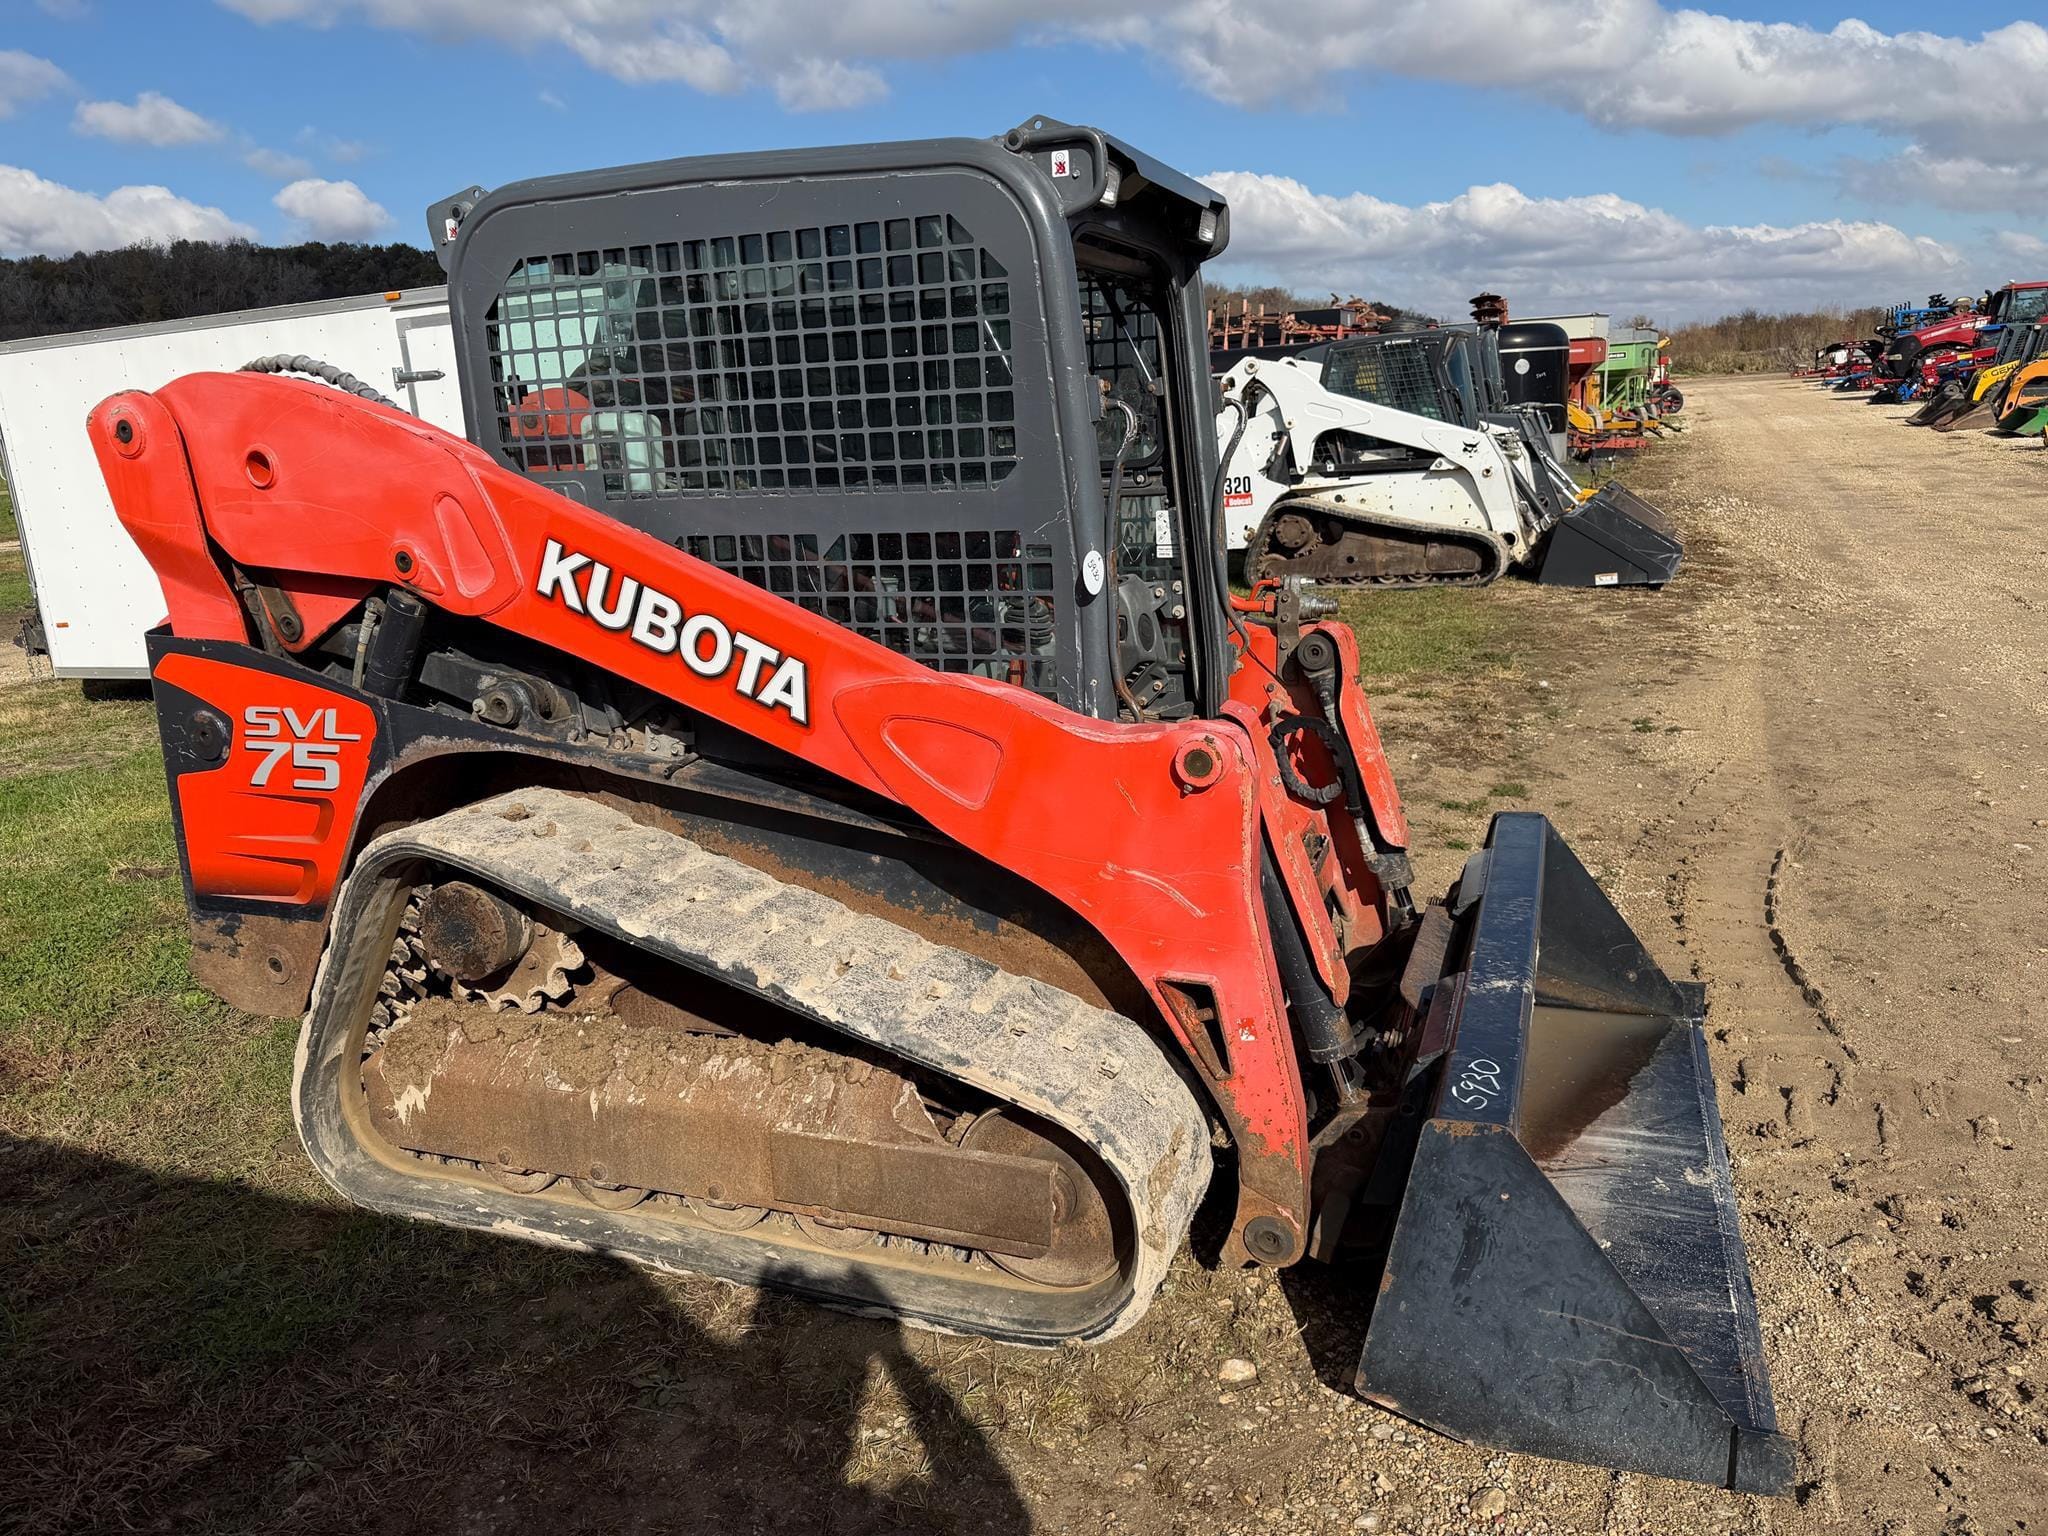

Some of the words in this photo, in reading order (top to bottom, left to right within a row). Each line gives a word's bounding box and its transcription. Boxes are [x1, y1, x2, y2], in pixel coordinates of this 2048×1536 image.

[1224, 476, 1251, 495] 320
[537, 538, 808, 725] KUBOTA
[244, 706, 361, 741] SVL
[244, 741, 340, 791] 75
